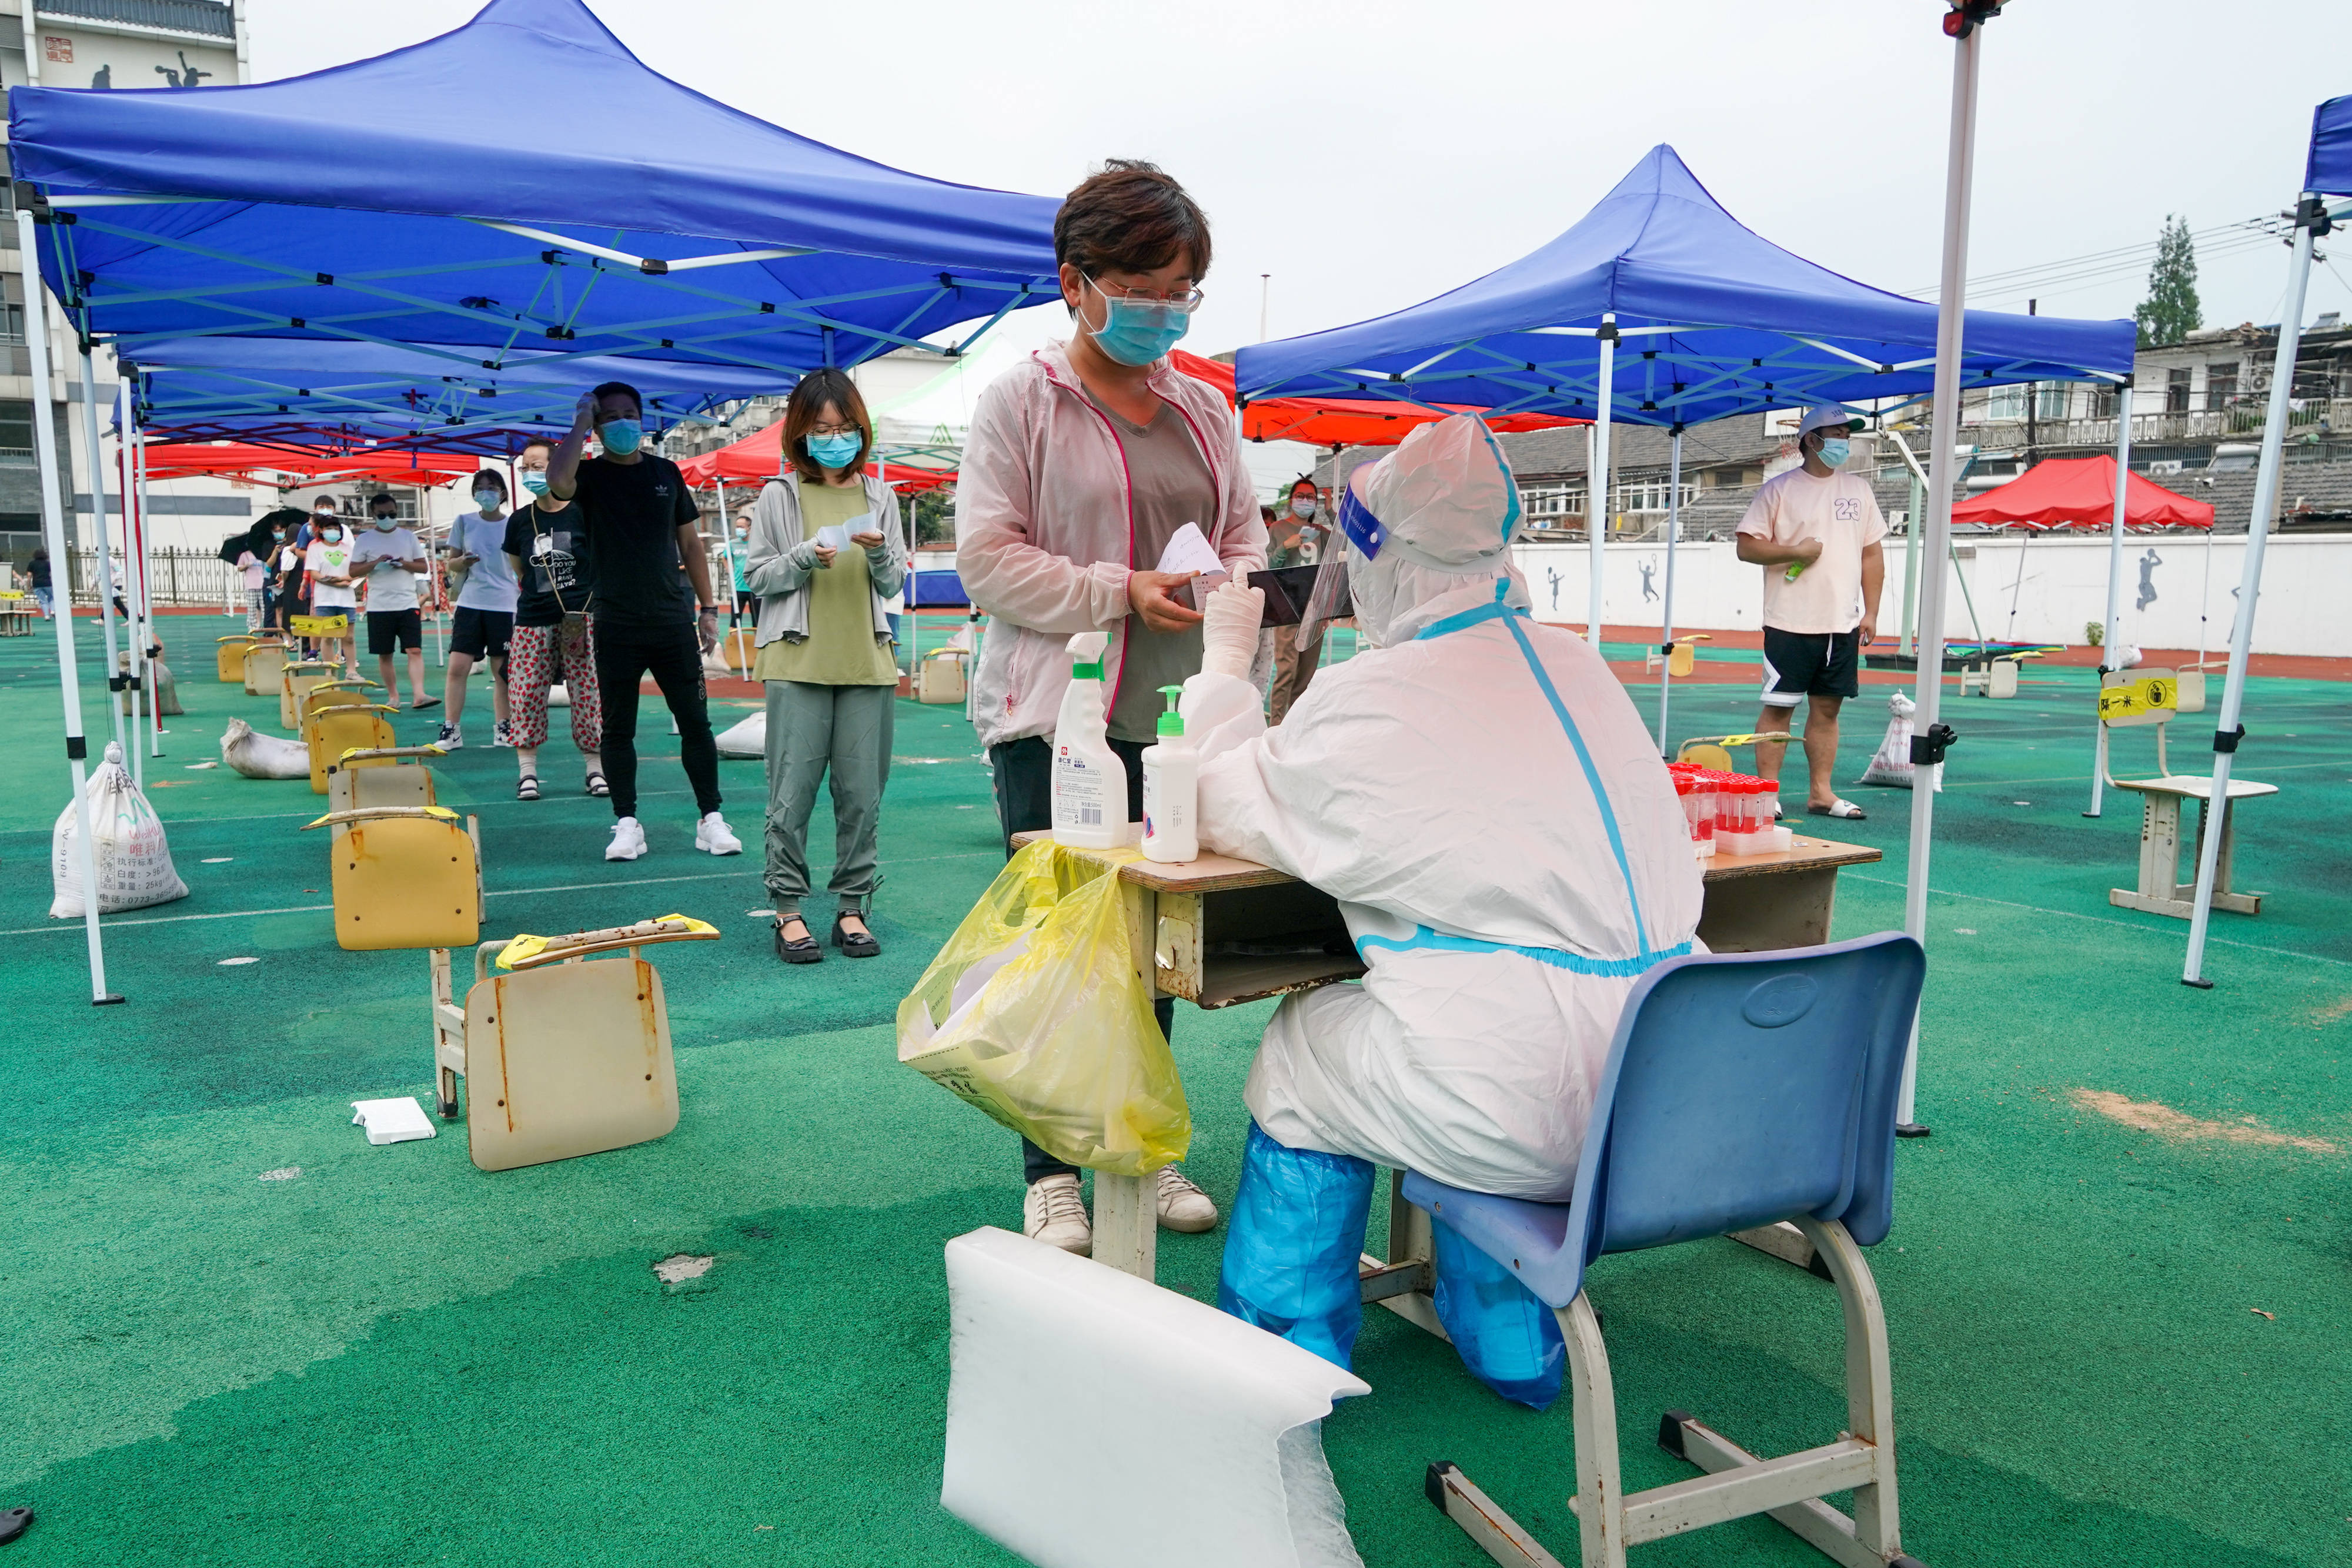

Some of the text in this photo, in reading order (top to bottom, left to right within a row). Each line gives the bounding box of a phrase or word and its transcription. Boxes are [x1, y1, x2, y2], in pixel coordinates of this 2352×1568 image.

[1835, 498, 1861, 521] 23
[1298, 541, 1318, 566] 9
[2098, 695, 2132, 712] 隔一米
